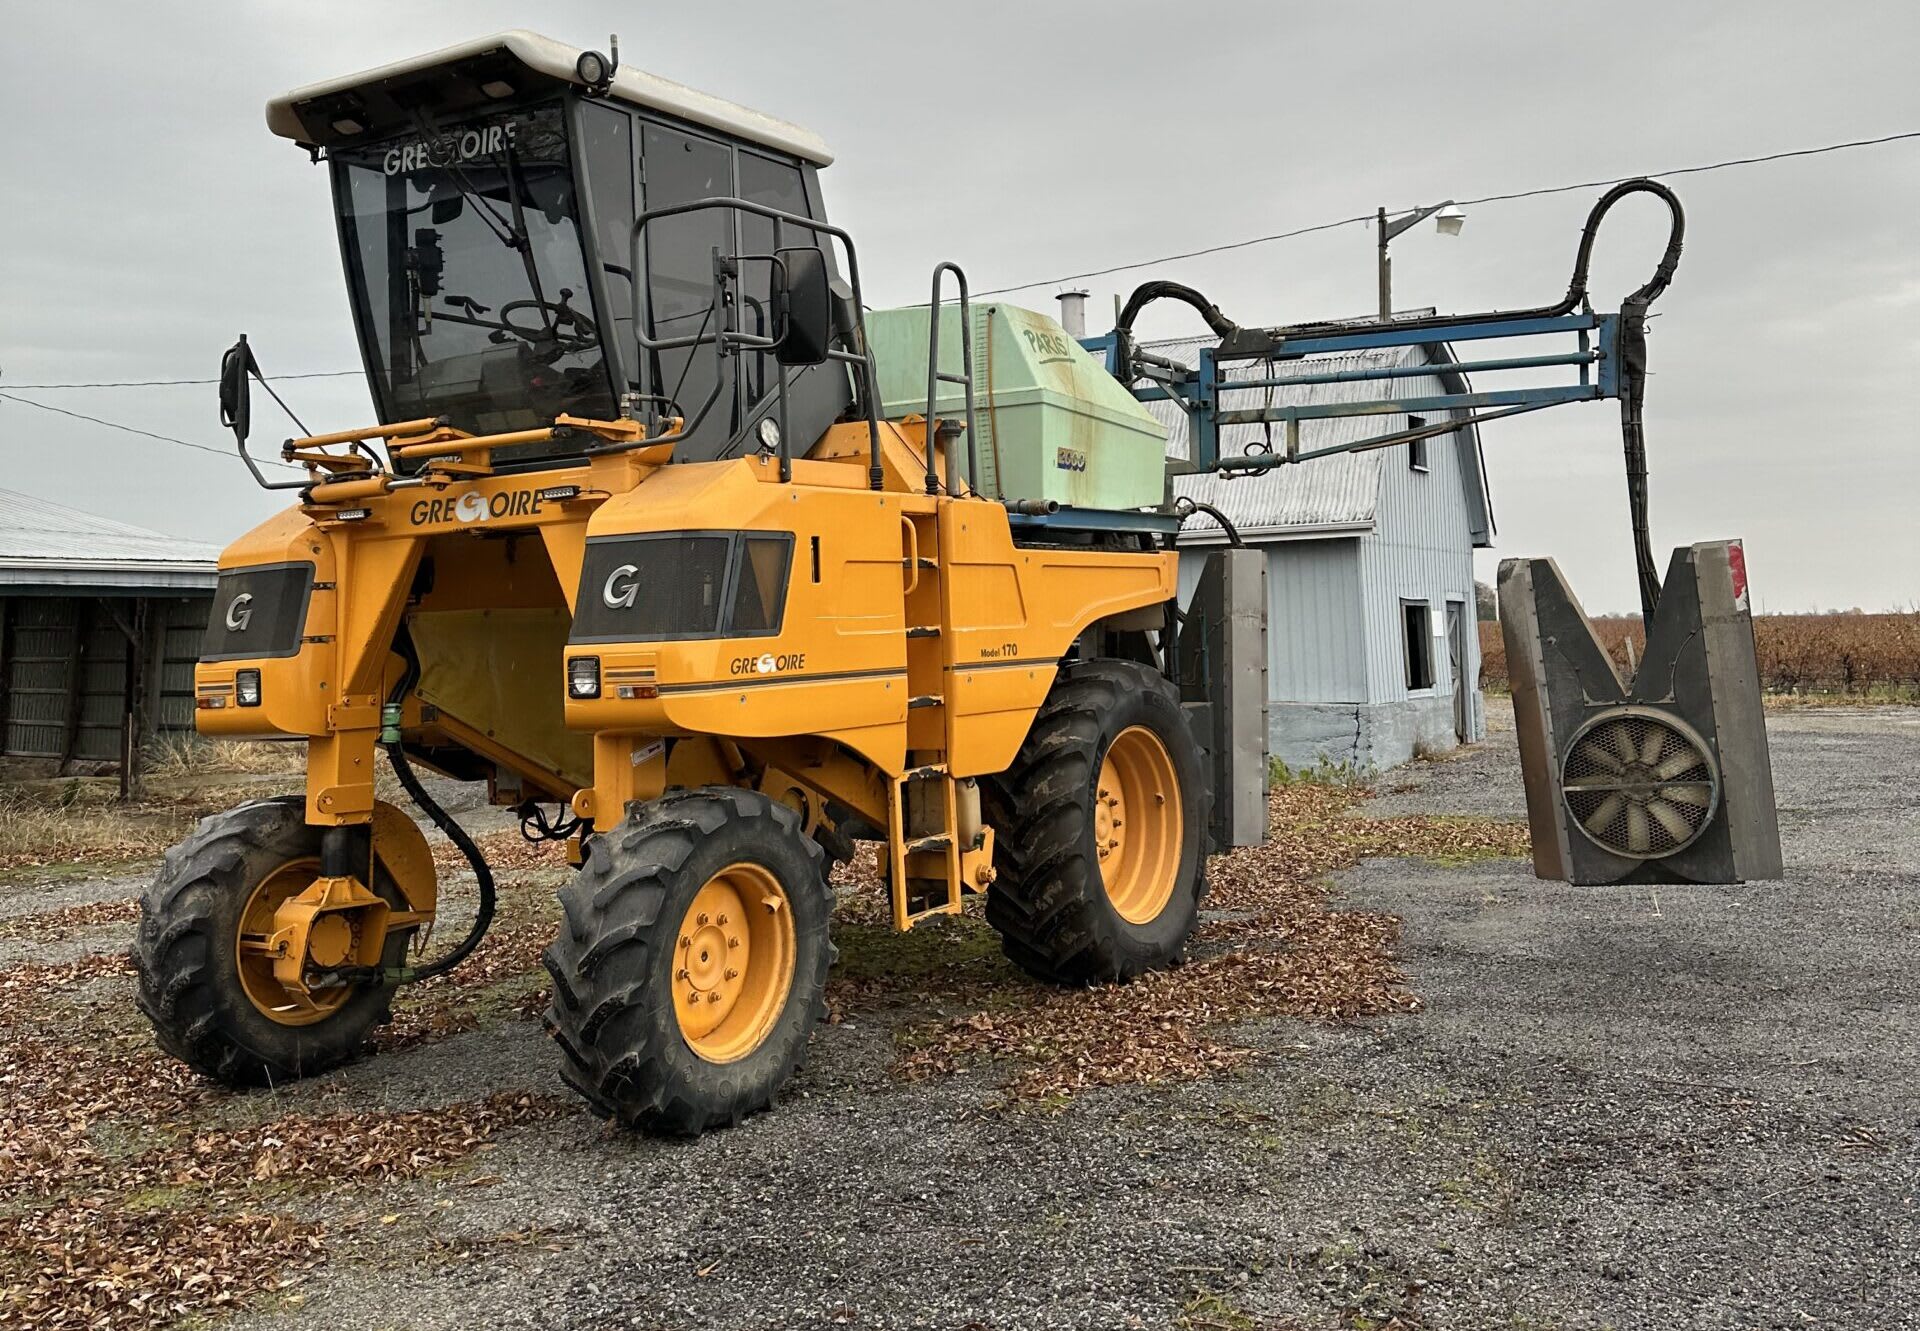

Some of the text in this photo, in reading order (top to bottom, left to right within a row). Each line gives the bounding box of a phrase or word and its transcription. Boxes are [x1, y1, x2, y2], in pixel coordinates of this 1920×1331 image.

[1023, 329, 1068, 357] PARIS
[410, 489, 544, 526] GREGOIRE
[603, 564, 640, 609] G
[226, 592, 253, 631] G
[730, 652, 806, 675] GREGOIRE
[980, 643, 1018, 657] Model 170
